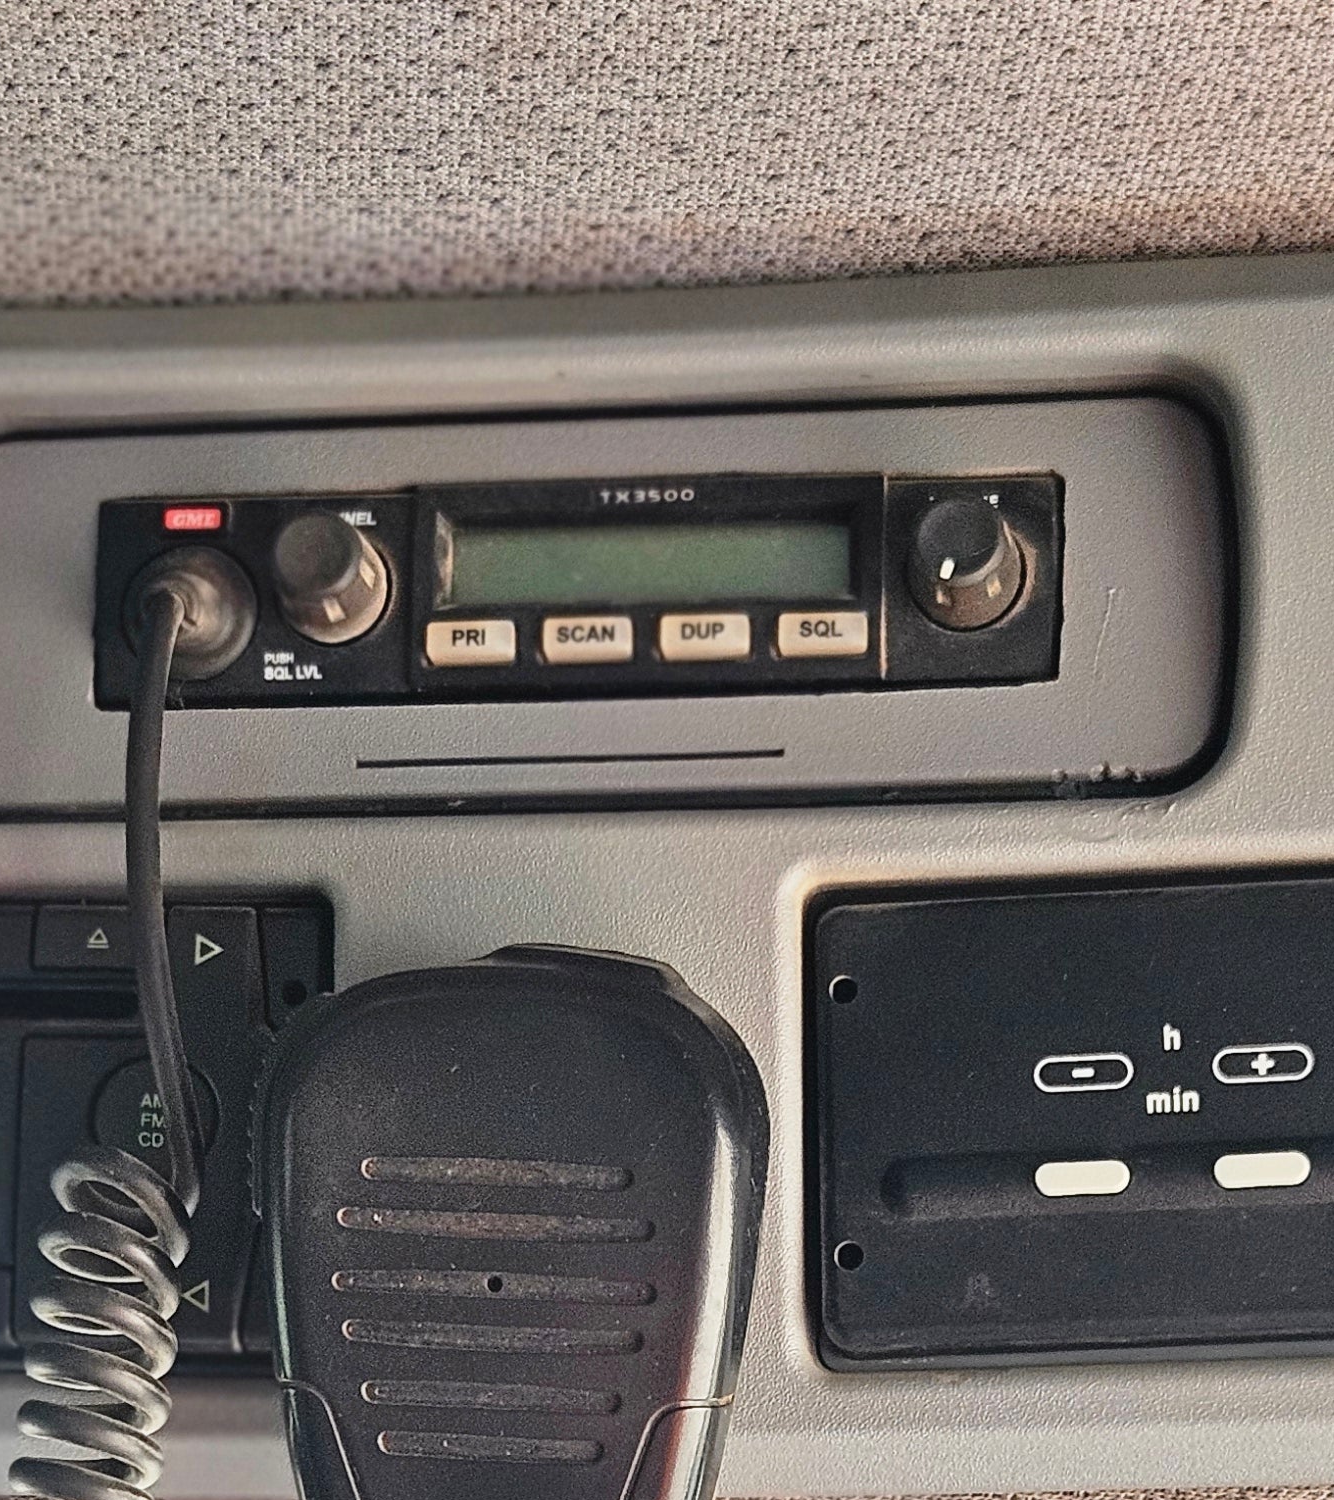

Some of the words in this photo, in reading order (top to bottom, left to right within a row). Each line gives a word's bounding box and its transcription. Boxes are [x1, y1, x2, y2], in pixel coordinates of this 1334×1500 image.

[599, 488, 696, 504] TX3500
[451, 628, 486, 646] PRI
[556, 624, 616, 643] SCAN
[680, 622, 725, 640] DUP
[798, 620, 843, 638] SQL
[263, 652, 295, 665] PUSH
[263, 666, 294, 681] SQL
[295, 665, 323, 681] LVL
[1162, 1022, 1182, 1051] h
[1145, 1084, 1201, 1115] min
[139, 1111, 167, 1129] FM
[137, 1130, 165, 1149] CD
